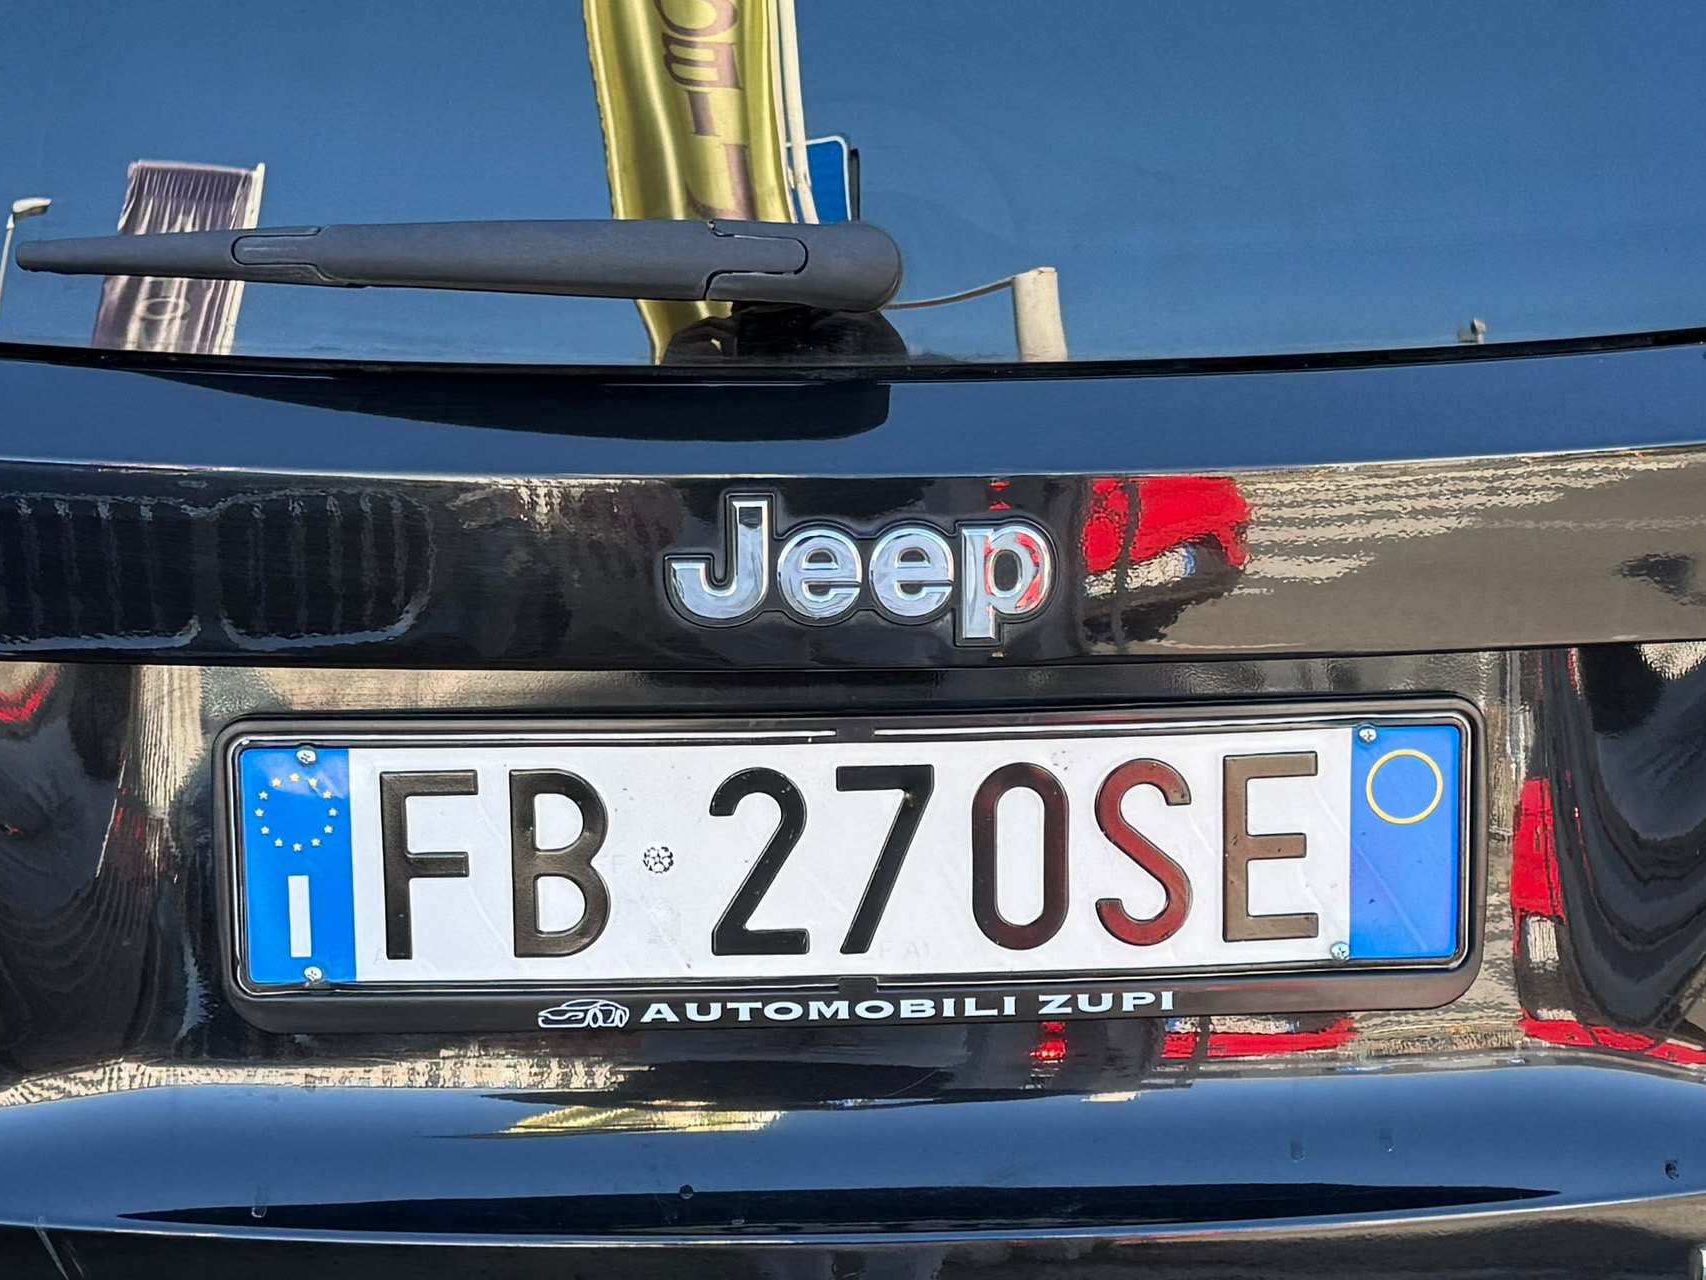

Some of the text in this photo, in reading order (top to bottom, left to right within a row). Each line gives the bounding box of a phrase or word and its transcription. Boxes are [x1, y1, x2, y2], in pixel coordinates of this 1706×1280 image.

[669, 492, 1051, 644] Jeep
[381, 768, 608, 960] FB
[709, 751, 1319, 956] 270SE
[639, 991, 1174, 1024] AUTOMOBILI ZUPI
